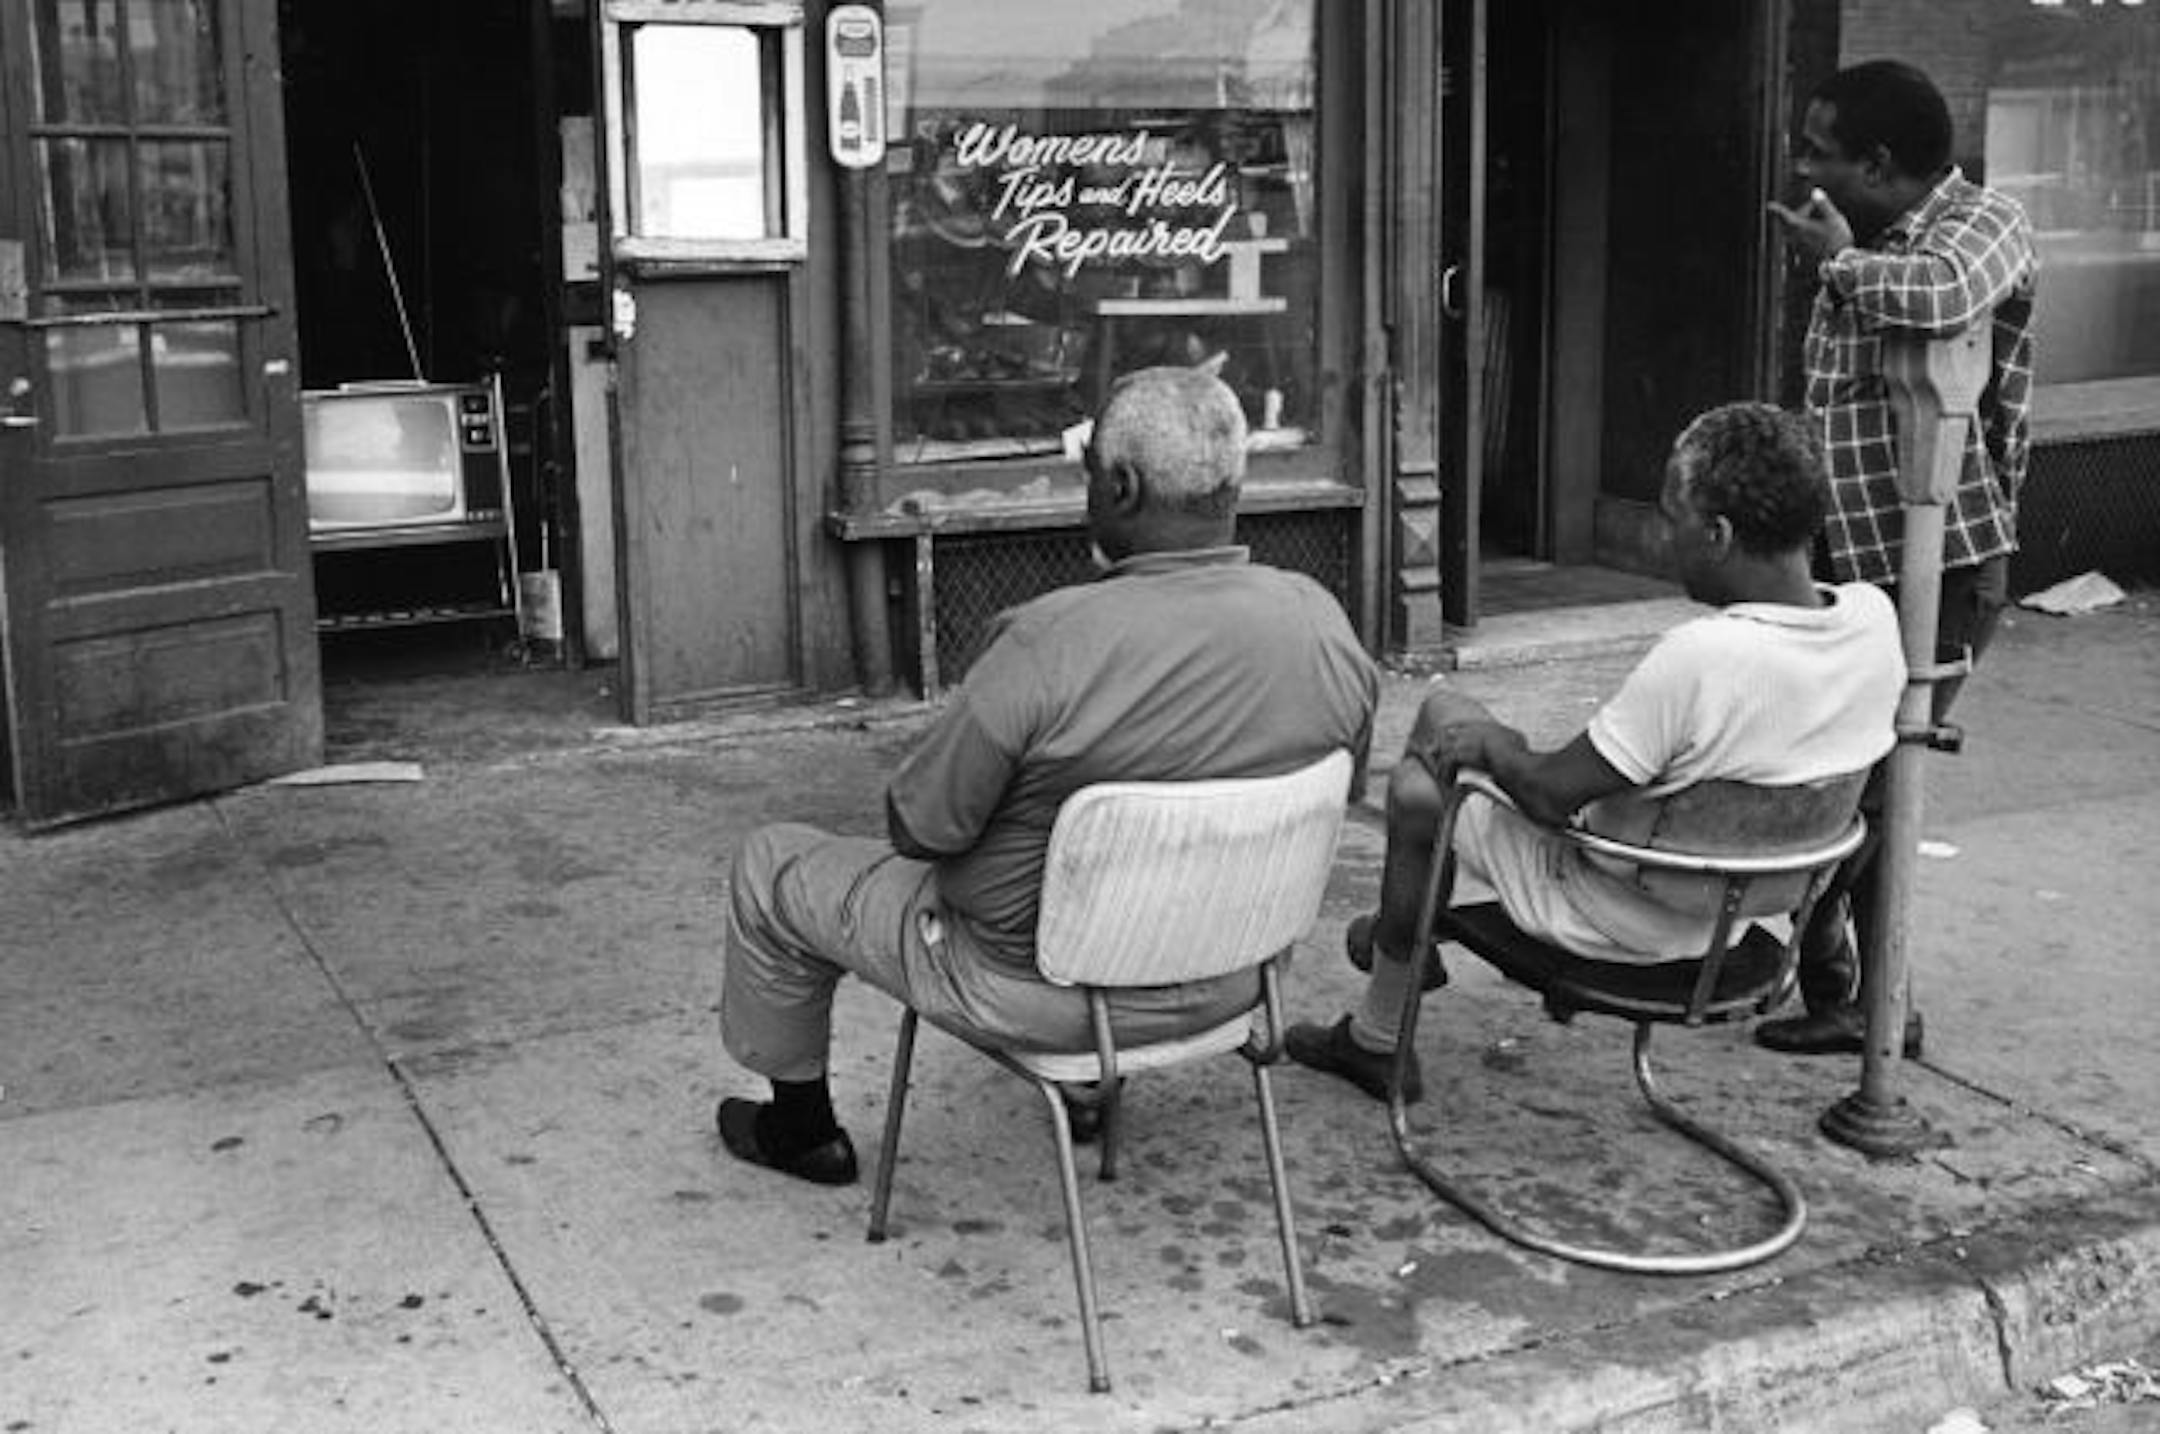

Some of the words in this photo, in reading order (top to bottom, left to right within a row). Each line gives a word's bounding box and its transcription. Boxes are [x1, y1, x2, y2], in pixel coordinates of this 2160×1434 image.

[954, 123, 1150, 166] Womens
[991, 165, 1075, 220] Tips
[1078, 179, 1132, 207] and
[1125, 161, 1228, 217] Heels
[1005, 204, 1238, 279] Repaired
